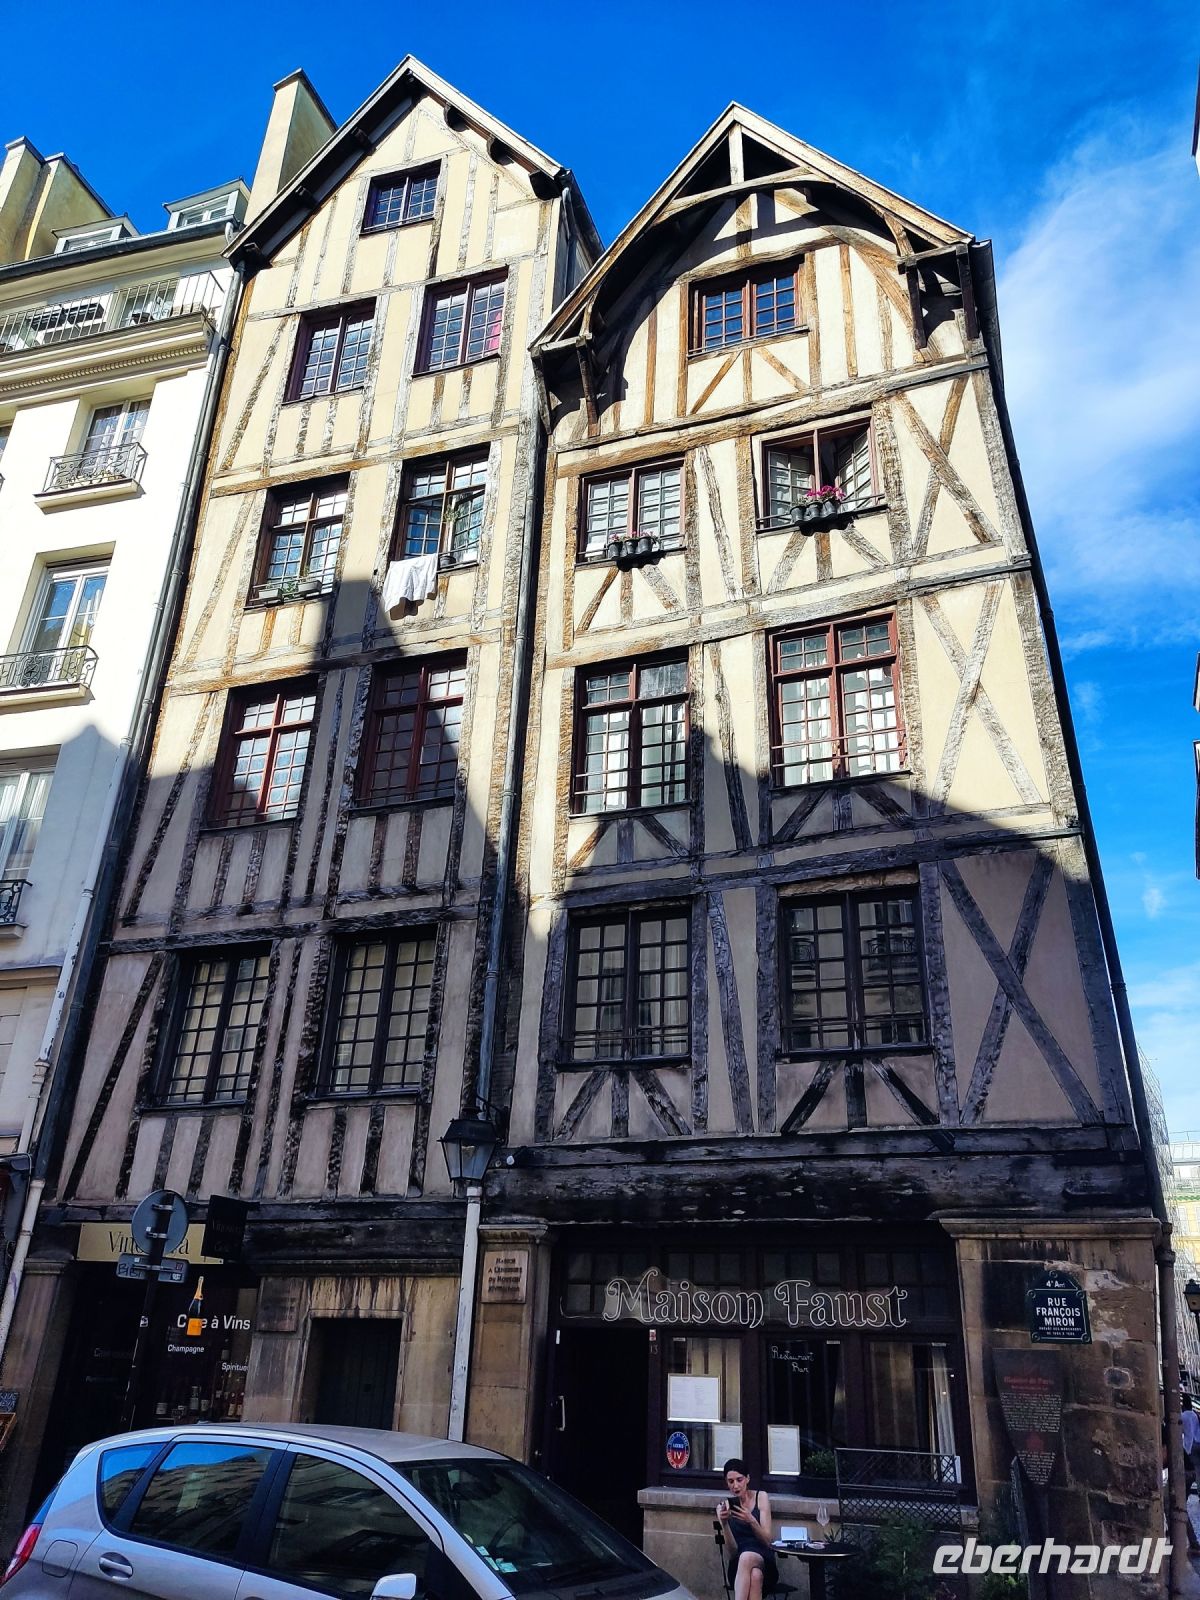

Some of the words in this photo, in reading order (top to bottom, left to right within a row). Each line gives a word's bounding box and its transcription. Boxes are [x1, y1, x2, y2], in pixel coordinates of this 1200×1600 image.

[602, 1268, 764, 1328] Maison
[774, 1279, 908, 1328] Faust
[1047, 1297, 1067, 1307] RUE
[1036, 1307, 1081, 1318] FRANÇOIS
[177, 1313, 208, 1329] Ce
[211, 1315, 219, 1329] à
[223, 1314, 251, 1330] Vins
[1044, 1317, 1075, 1327] MIRON
[167, 1344, 205, 1355] Champagne
[673, 1451, 682, 1460] IV
